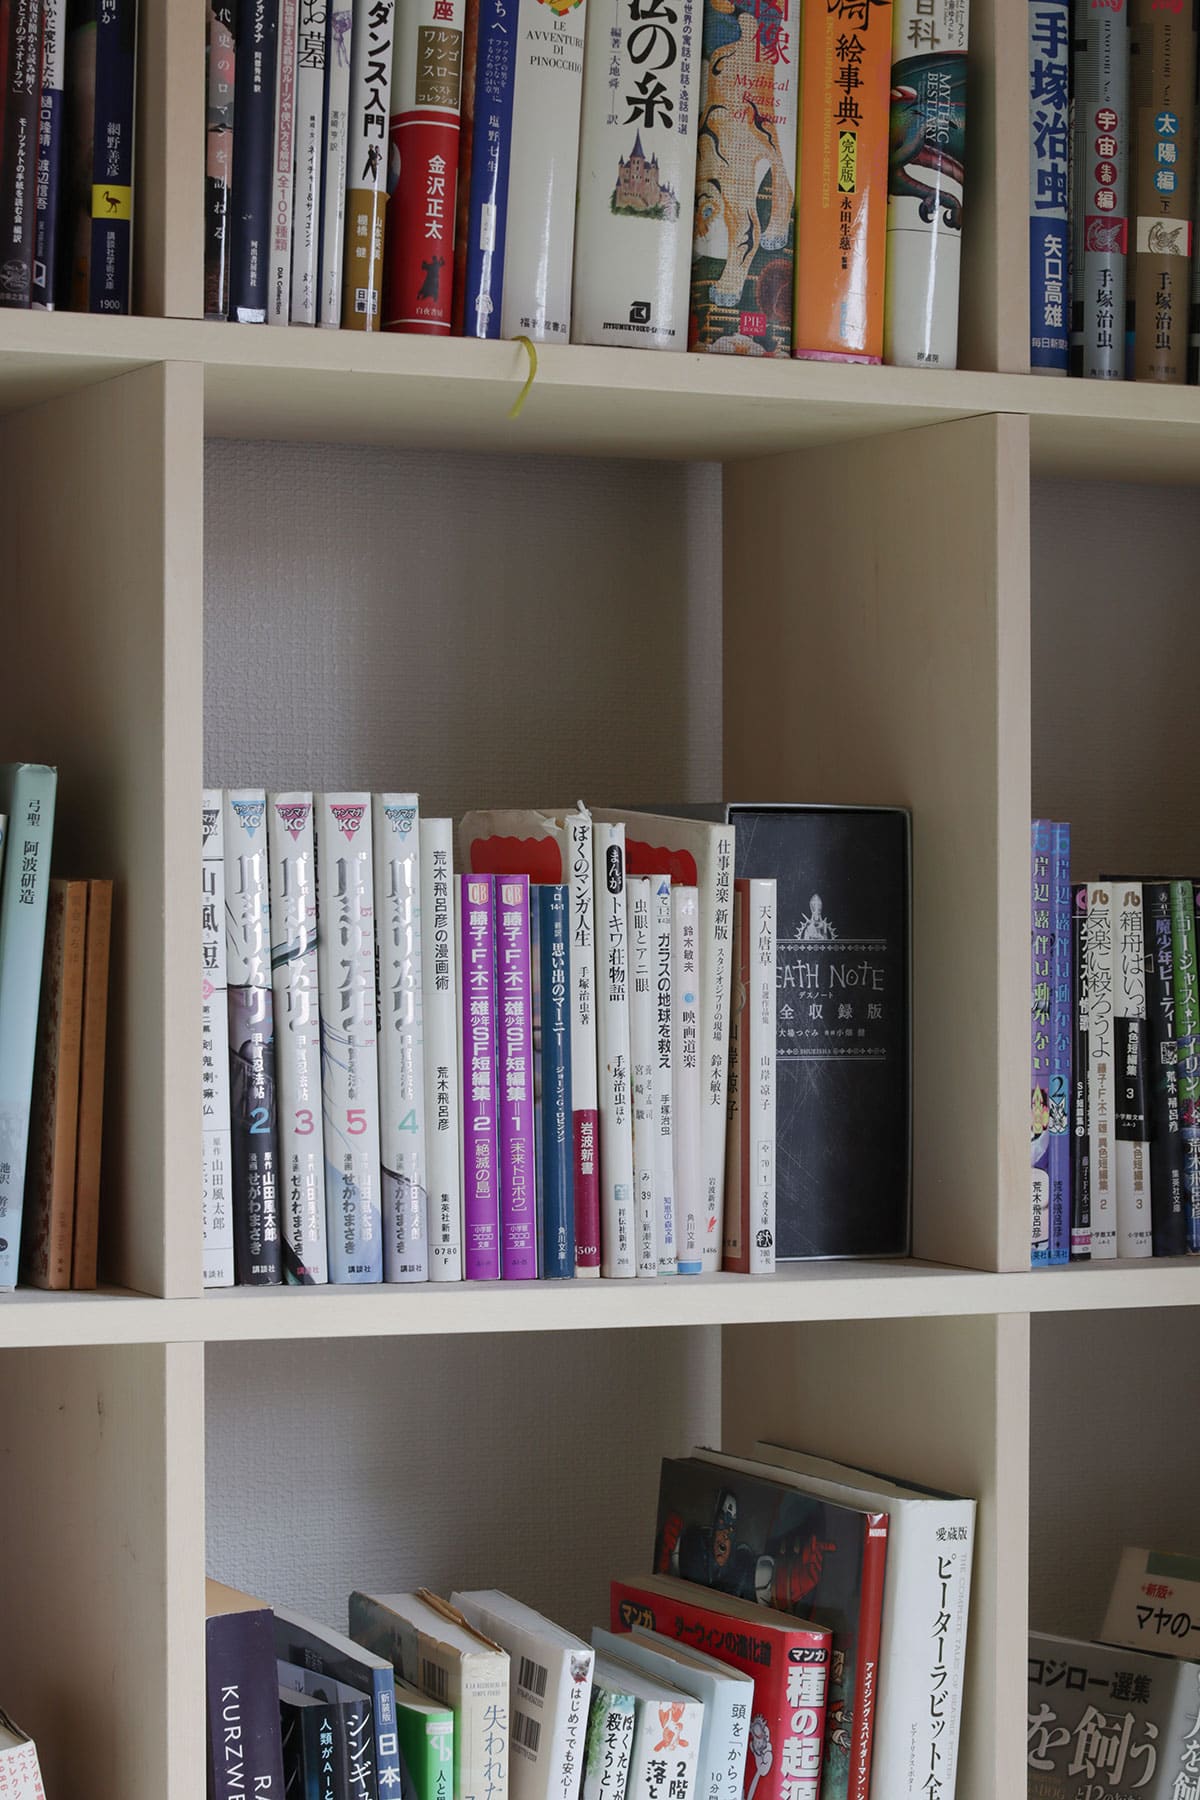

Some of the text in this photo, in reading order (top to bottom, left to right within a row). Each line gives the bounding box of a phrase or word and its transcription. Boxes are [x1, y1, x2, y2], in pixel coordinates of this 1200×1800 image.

[423, 29, 460, 46] ワルツ
[553, 20, 567, 31] LE
[363, 2, 392, 139] ダンス入門
[423, 46, 459, 62] タンゴ
[423, 64, 459, 78] スロー
[530, 54, 582, 74] PINOCCHIO
[553, 44, 565, 55] DI
[418, 94, 459, 106] コレクション
[429, 85, 451, 94] ベスト
[734, 74, 789, 91] Mythical
[925, 72, 939, 143] BESTIARY
[937, 72, 953, 145] MYTHIC
[1030, 11, 1068, 212] 手塚治虫
[105, 122, 121, 177] 網野善彦
[840, 139, 855, 184] 完全版
[1155, 113, 1178, 192] 太陽編
[424, 154, 446, 240] 金沢正太
[839, 197, 852, 251] 永田生慈
[1044, 234, 1063, 328] 矢口高雄
[100, 299, 121, 310] 1900
[1096, 269, 1114, 350] 手塚治虫
[1155, 272, 1172, 351] 手塚治虫
[234, 804, 263, 816] ヤンマガ
[240, 815, 261, 829] KC
[277, 806, 310, 818] ヤンマガ
[284, 818, 305, 831] KC
[332, 808, 364, 818] ヤンマガ
[338, 818, 360, 831] KC
[385, 808, 415, 819] ヤンマガ
[392, 819, 412, 832] KC
[19, 799, 41, 904] 弓聖 阿波研造
[608, 848, 622, 891] まんが
[433, 850, 450, 991] 荒木飛呂彦の漫画術
[759, 905, 772, 967] 天人唐草
[608, 897, 626, 1002] トキワ荘物語
[634, 899, 649, 993] 虫眼とアニ眼
[683, 926, 694, 973] 鈴木敏夫
[1033, 856, 1050, 1070] 岸辺露伴は動かない
[1054, 860, 1071, 1070] 岸辺露伴は動かない
[710, 839, 731, 1106] 仕事道楽 新版 スタジオジブリの現場 鈴木敏夫
[1087, 908, 1111, 1058] 気楽に殺ろうよ
[1155, 917, 1175, 1038] 魔少年ビーティー
[552, 943, 566, 1047] 思い出のマーニー
[657, 932, 672, 1068] ガラスの地球を救え
[779, 1003, 883, 1020] 全収録版
[682, 1011, 696, 1069] 映画道楽
[252, 1033, 265, 1100] 甲賀忍法帖
[1051, 1076, 1065, 1098] 2
[437, 1066, 450, 1132] 荒木飛呂彦
[613, 1055, 626, 1125] 手塚治虫ほか
[635, 1065, 646, 1121] 宮崎駿
[1126, 1088, 1134, 1099] 3
[250, 1107, 271, 1134] 2
[294, 1109, 315, 1135] 3
[346, 1109, 367, 1135] 5
[397, 1109, 419, 1134] 4
[661, 1094, 671, 1136] 手塚治虫
[580, 1122, 594, 1175] 岩波新書
[212, 1159, 226, 1230] 山田風太郎
[248, 1173, 262, 1255] せがわまさき
[262, 1173, 277, 1243] 山田風太郎
[342, 1174, 356, 1255] せがわまさき
[641, 1191, 652, 1201] 39
[708, 1177, 716, 1211] 岩波新書
[1032, 1181, 1043, 1239] 荒木飛呂彦
[1099, 1199, 1107, 1210] 2
[1136, 1199, 1143, 1209] 3
[441, 1193, 450, 1243] 集英社新書
[434, 1247, 457, 1256] 0780
[444, 1257, 449, 1266] F
[558, 1227, 567, 1260] 角川文庫
[252, 1264, 276, 1274] 講談社
[348, 1265, 371, 1274] 講談社
[400, 1265, 423, 1274] 講談社
[936, 1526, 968, 1543] 愛蔵版
[674, 1615, 772, 1668] ダーウィンの進化論
[791, 1649, 826, 1664] マンガ
[1028, 1703, 1160, 1788] を飼う
